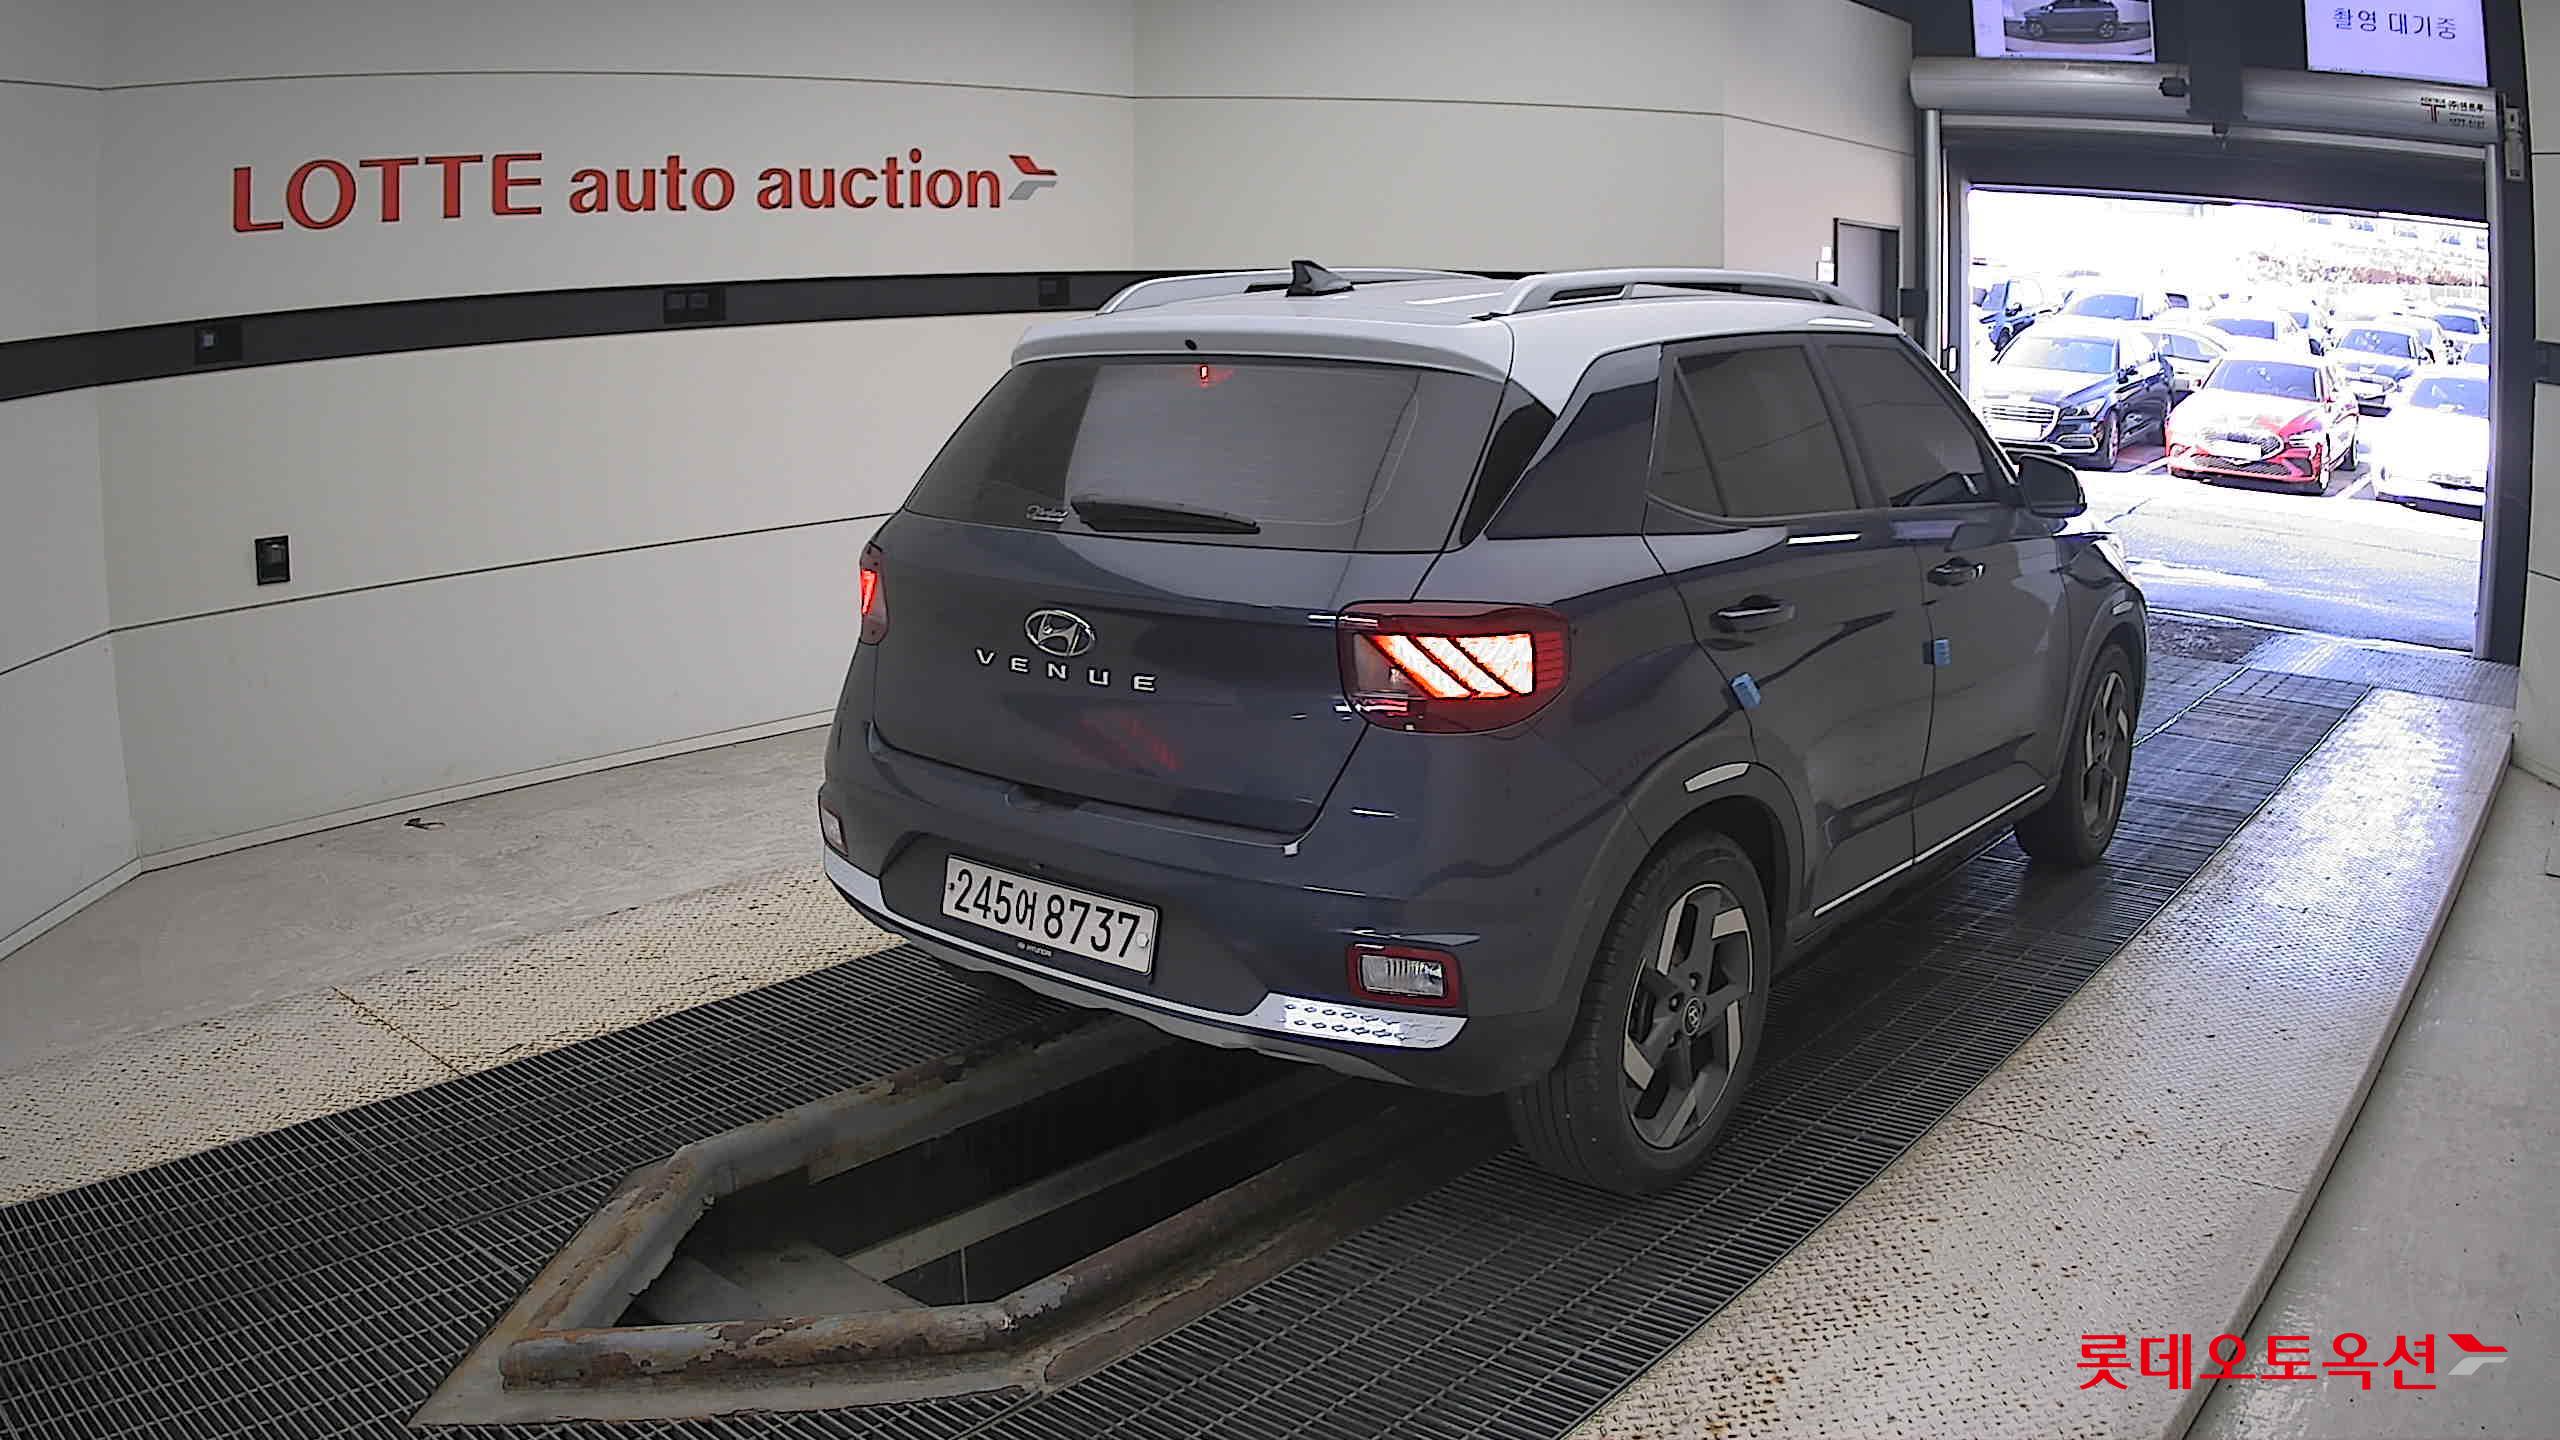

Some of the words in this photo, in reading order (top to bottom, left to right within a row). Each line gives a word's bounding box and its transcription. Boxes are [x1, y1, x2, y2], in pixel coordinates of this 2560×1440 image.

[2388, 13, 2457, 40] 대기중
[233, 152, 542, 232] LOTTE
[568, 154, 735, 213] auto
[757, 147, 1001, 210] auction
[976, 649, 1156, 692] VENUE
